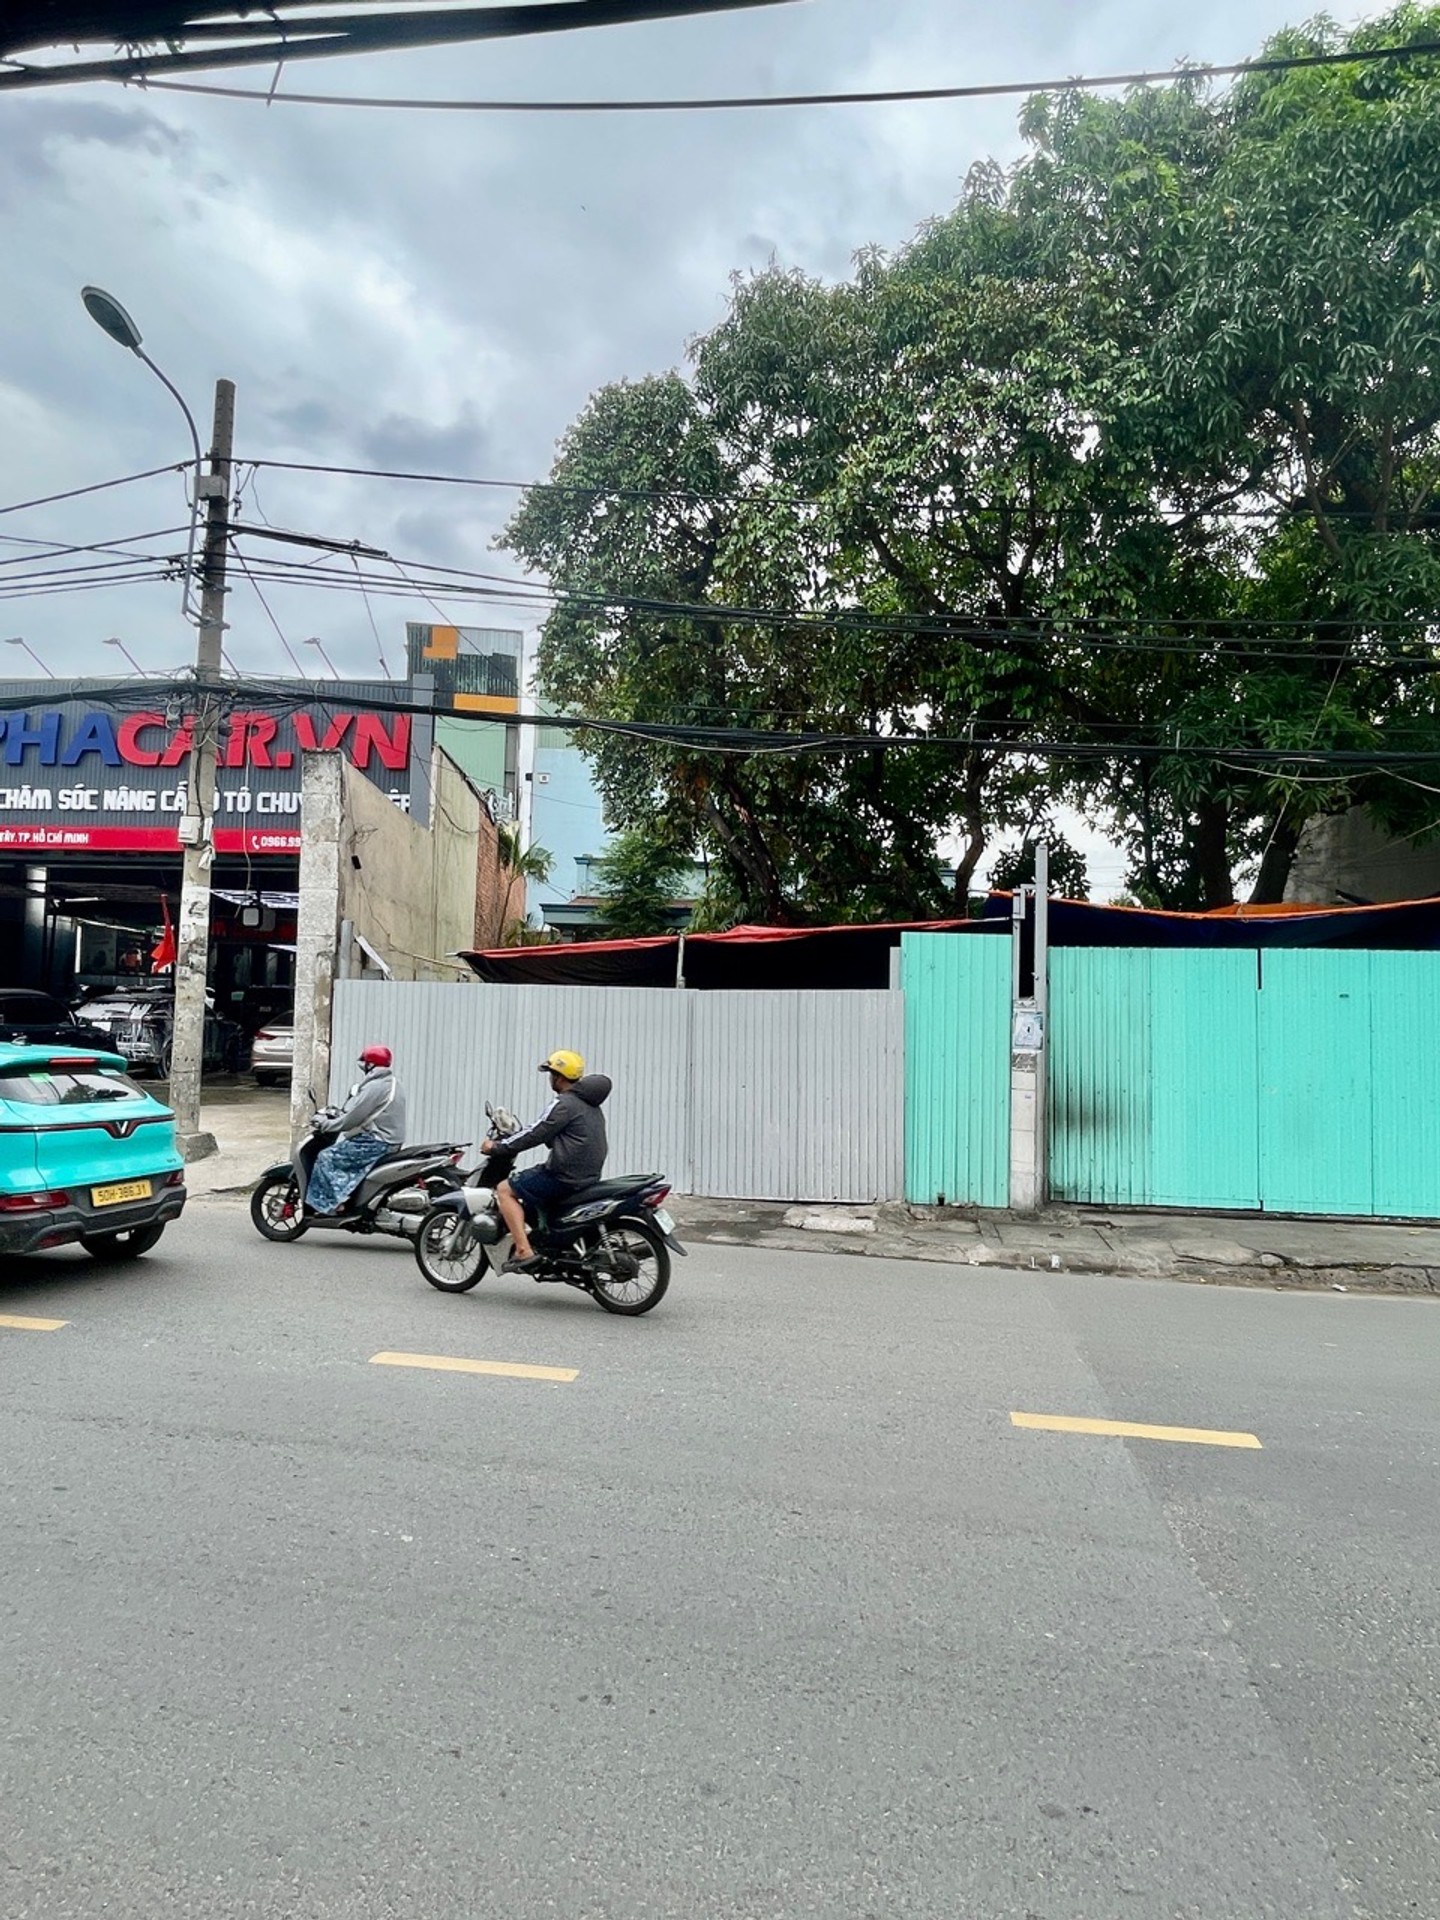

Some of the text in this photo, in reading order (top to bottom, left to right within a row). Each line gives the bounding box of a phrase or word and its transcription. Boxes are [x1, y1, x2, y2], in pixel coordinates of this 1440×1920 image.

[0, 785, 52, 810] CHĂM
[58, 783, 98, 810] SÓC
[103, 786, 156, 811] NÂNG
[224, 785, 252, 812] TÔ
